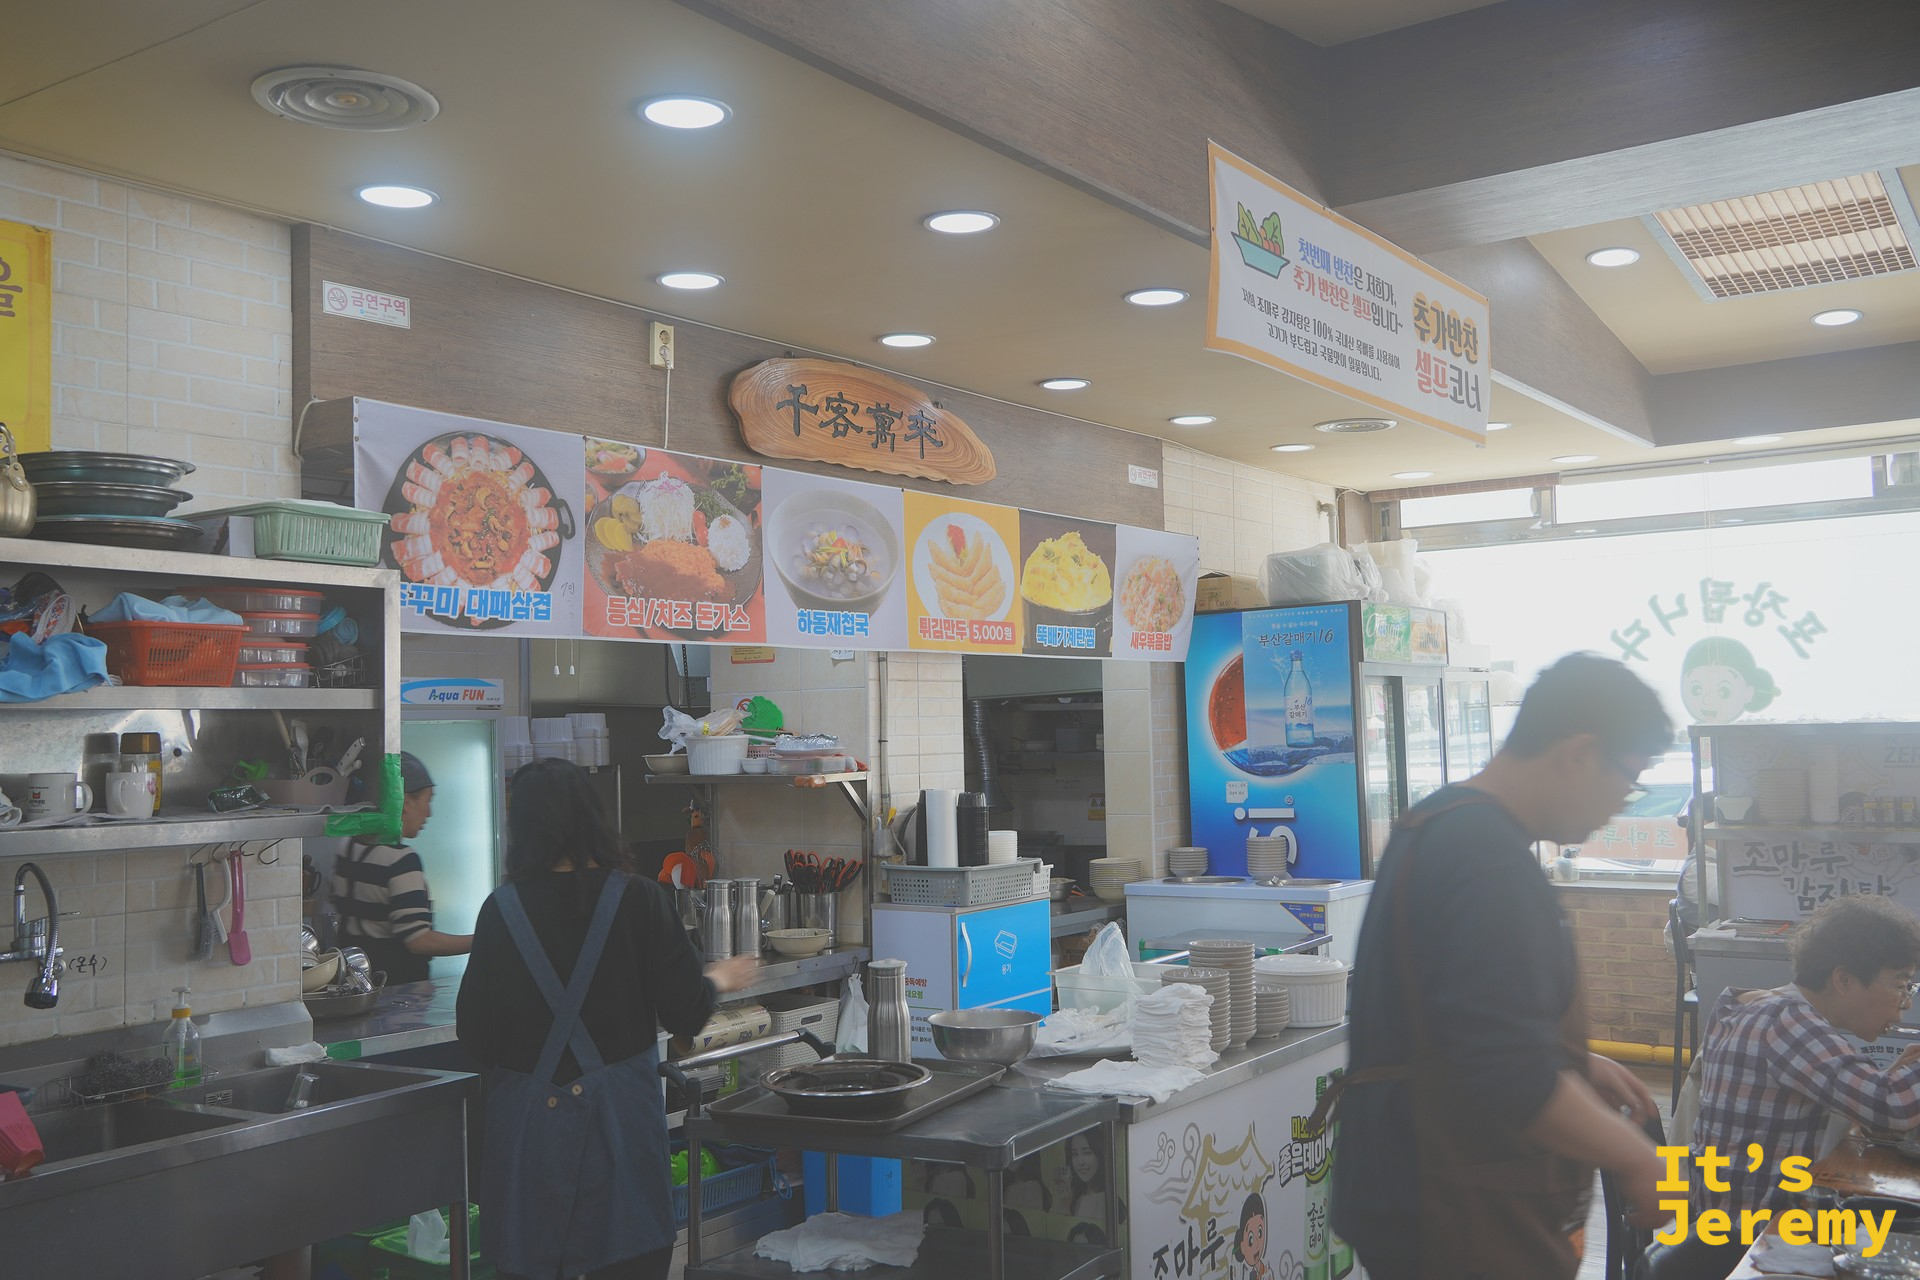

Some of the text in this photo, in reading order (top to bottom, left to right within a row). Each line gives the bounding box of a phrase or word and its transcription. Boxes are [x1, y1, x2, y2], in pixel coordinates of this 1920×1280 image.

[1298, 237, 1397, 308] 첫번째 반찬은 저희가,
[351, 290, 406, 317] 금연구역
[1293, 265, 1404, 335] 추가 반찬은 셀프입니다~
[1241, 287, 1257, 309] 저희
[1257, 296, 1280, 319] 조마루
[1281, 306, 1311, 333] 감자탕은
[1312, 318, 1334, 342] 100%
[1334, 329, 1355, 351] 국내산
[1376, 348, 1401, 370] 사용하여
[1413, 297, 1479, 365] 추가반찬
[1266, 322, 1383, 382] 고기가 부드럽고 국물맛이 일품입니다.
[1414, 348, 1482, 413] 셀프코너
[775, 383, 944, 460] 千客萬來
[465, 588, 553, 622] 대패삼겹
[607, 595, 693, 629] 등심/치즈
[696, 601, 751, 632] 돈가스
[796, 608, 870, 638] 하동재첩국
[918, 616, 1013, 643] 튀김만두 5,000원
[1036, 624, 1096, 650] 뚝배기계란찜
[1130, 630, 1174, 652] 새우볶음밥
[428, 688, 486, 702] Aqua FUN
[1293, 703, 1306, 711] 부산
[1288, 710, 1308, 719] 갈매기
[1732, 840, 1849, 875] 조마루
[1001, 962, 1012, 976] 용기
[1279, 1134, 1327, 1188] 좋은데이
[1307, 1203, 1325, 1232] 좋은
[1309, 1232, 1324, 1249] 데이
